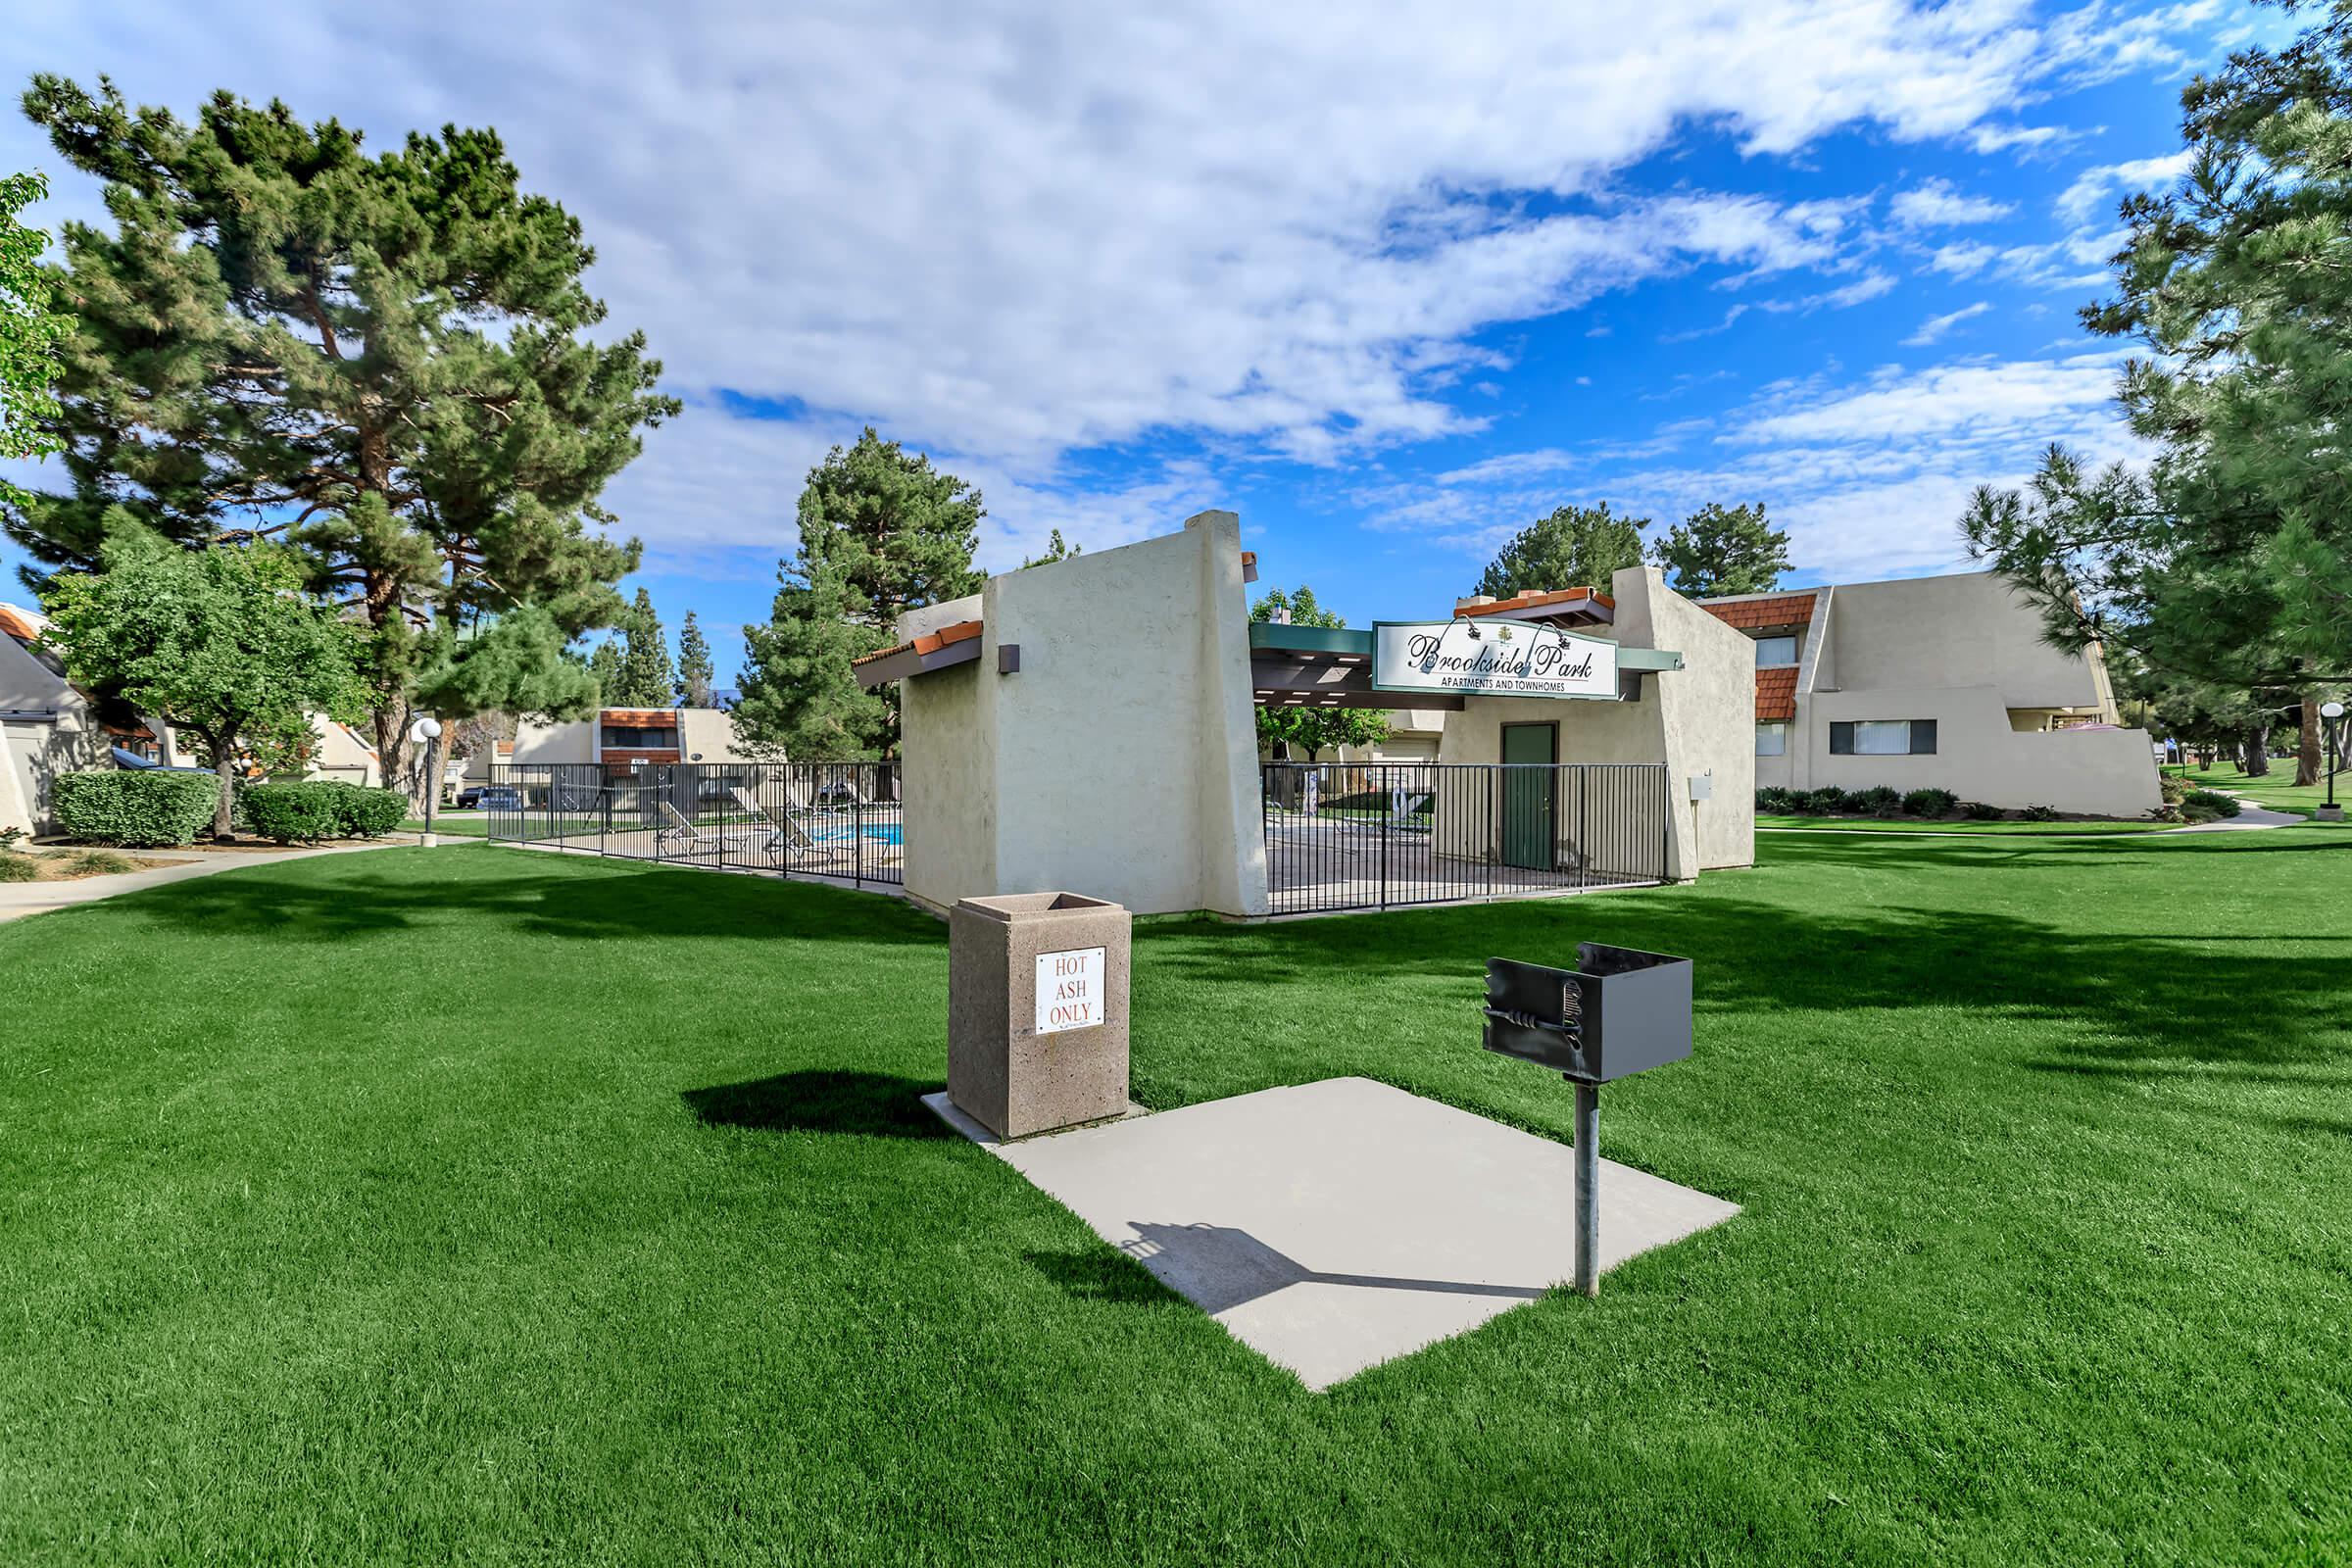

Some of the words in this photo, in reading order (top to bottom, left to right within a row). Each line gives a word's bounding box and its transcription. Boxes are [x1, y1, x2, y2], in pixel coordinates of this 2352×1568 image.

[1407, 634, 1523, 674] Brookside
[1535, 644, 1592, 678] Park
[1442, 677, 1494, 689] APARTMENTS
[1495, 679, 1513, 690] AND
[1516, 680, 1565, 692] TOWNHOMES
[1056, 956, 1087, 976] HOT
[1055, 980, 1086, 1001] ASH
[1051, 1002, 1091, 1025] ONLY
